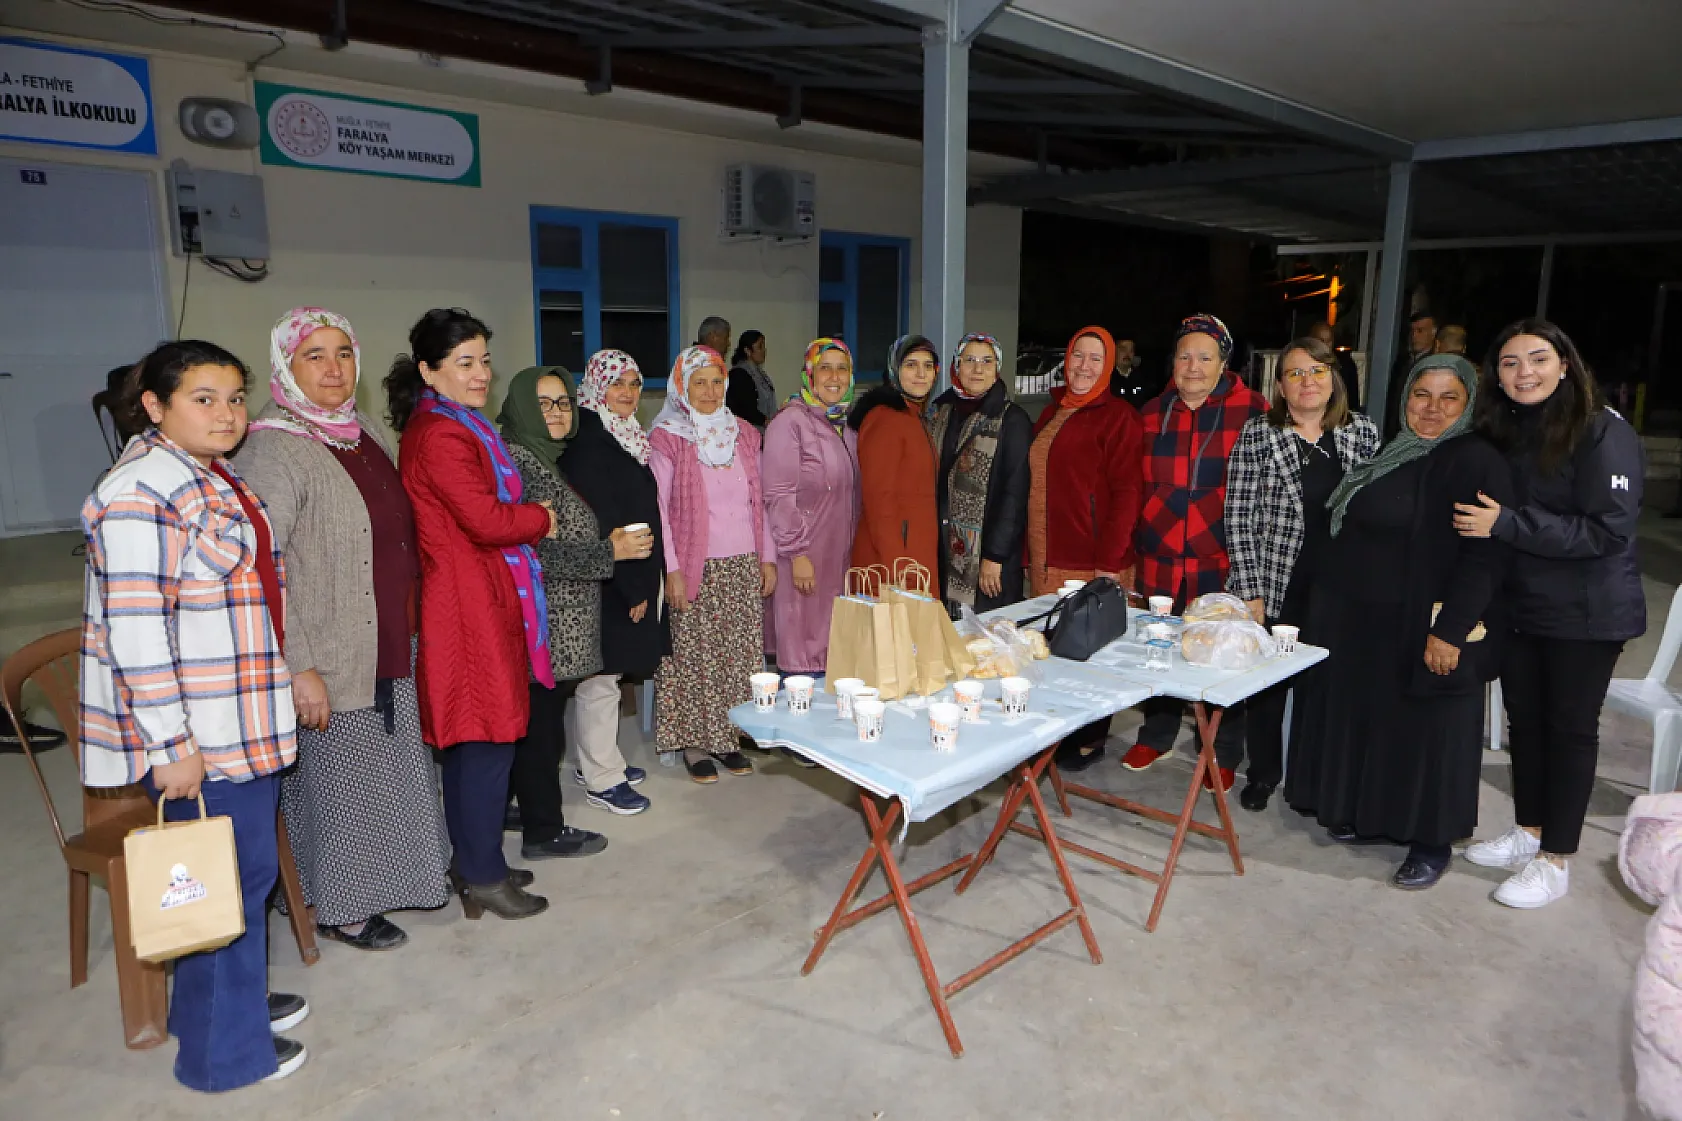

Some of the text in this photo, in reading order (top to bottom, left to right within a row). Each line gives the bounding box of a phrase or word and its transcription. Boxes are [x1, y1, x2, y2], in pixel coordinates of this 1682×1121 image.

[22, 75, 74, 93] FETHİYE
[52, 95, 136, 125] İLKOKULU
[337, 127, 389, 144] FARALYA
[338, 142, 455, 166] KÖY YAŞAM MERKEZİ
